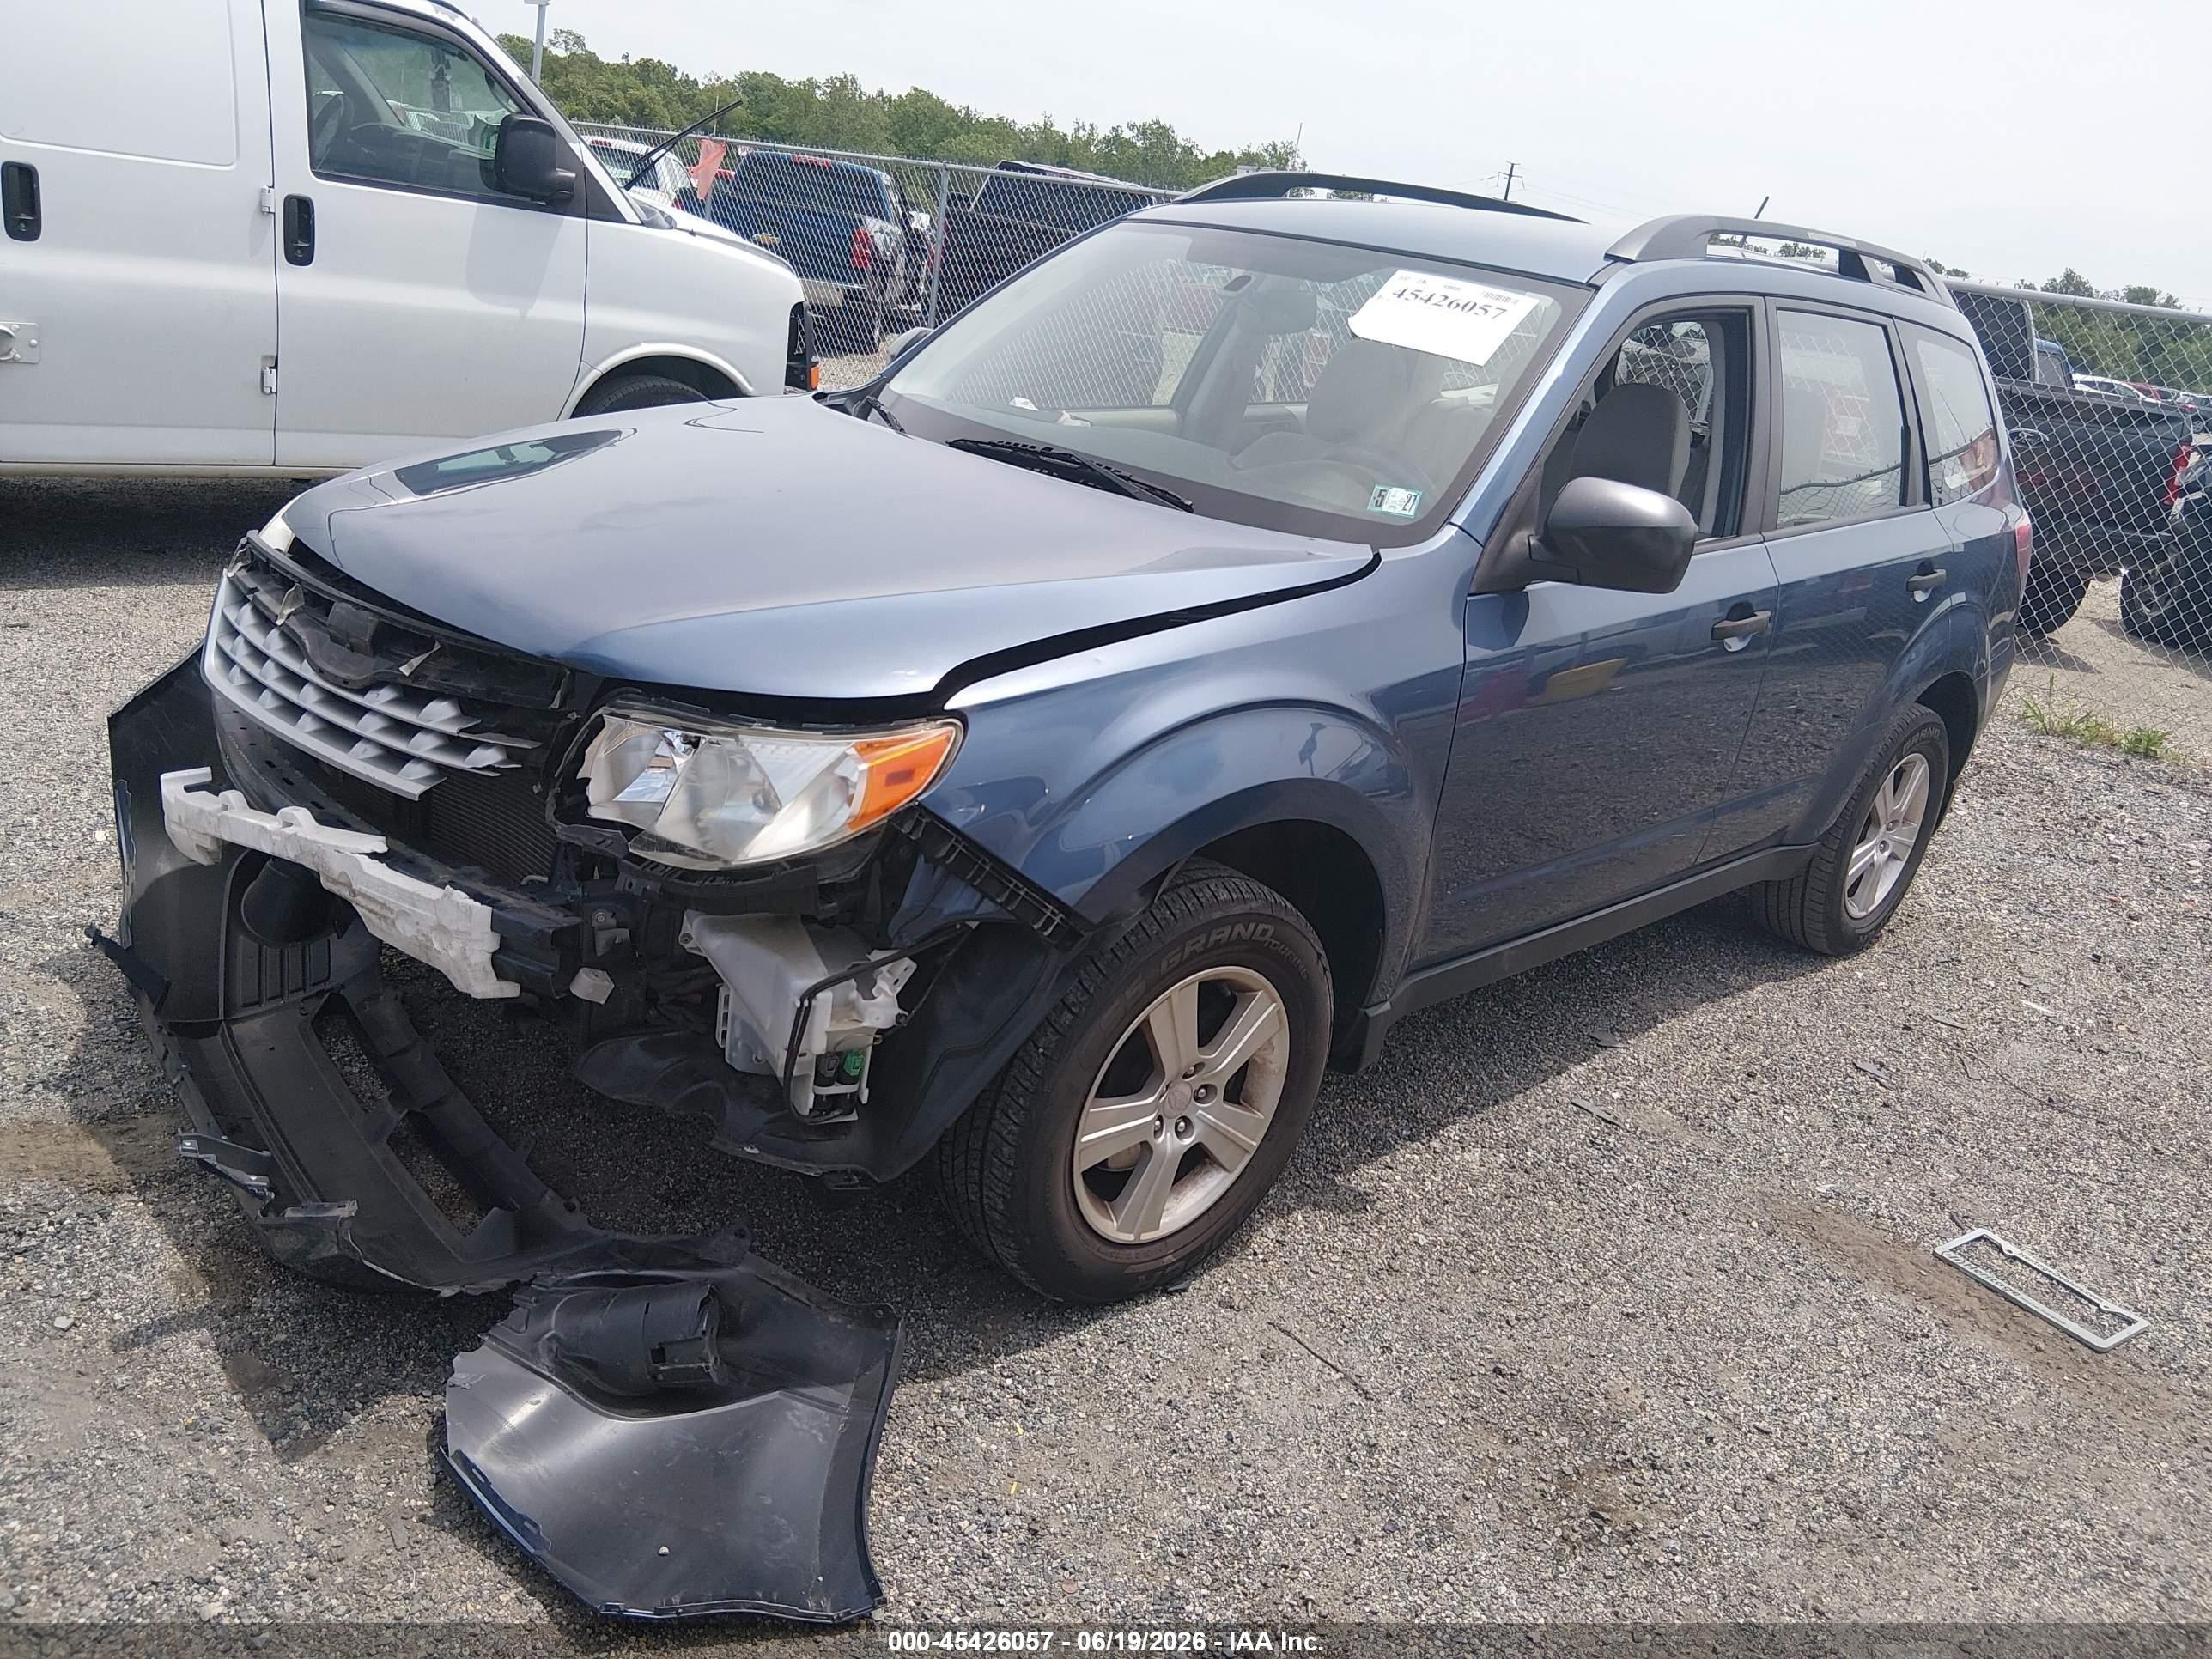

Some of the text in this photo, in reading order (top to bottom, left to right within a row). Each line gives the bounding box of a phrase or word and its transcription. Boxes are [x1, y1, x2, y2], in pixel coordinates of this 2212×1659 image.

[1392, 287, 1508, 320] 45426057
[1401, 493, 1418, 514] 27
[1160, 921, 1275, 975] GRAND
[1963, 1262, 2021, 1297] Heritage
